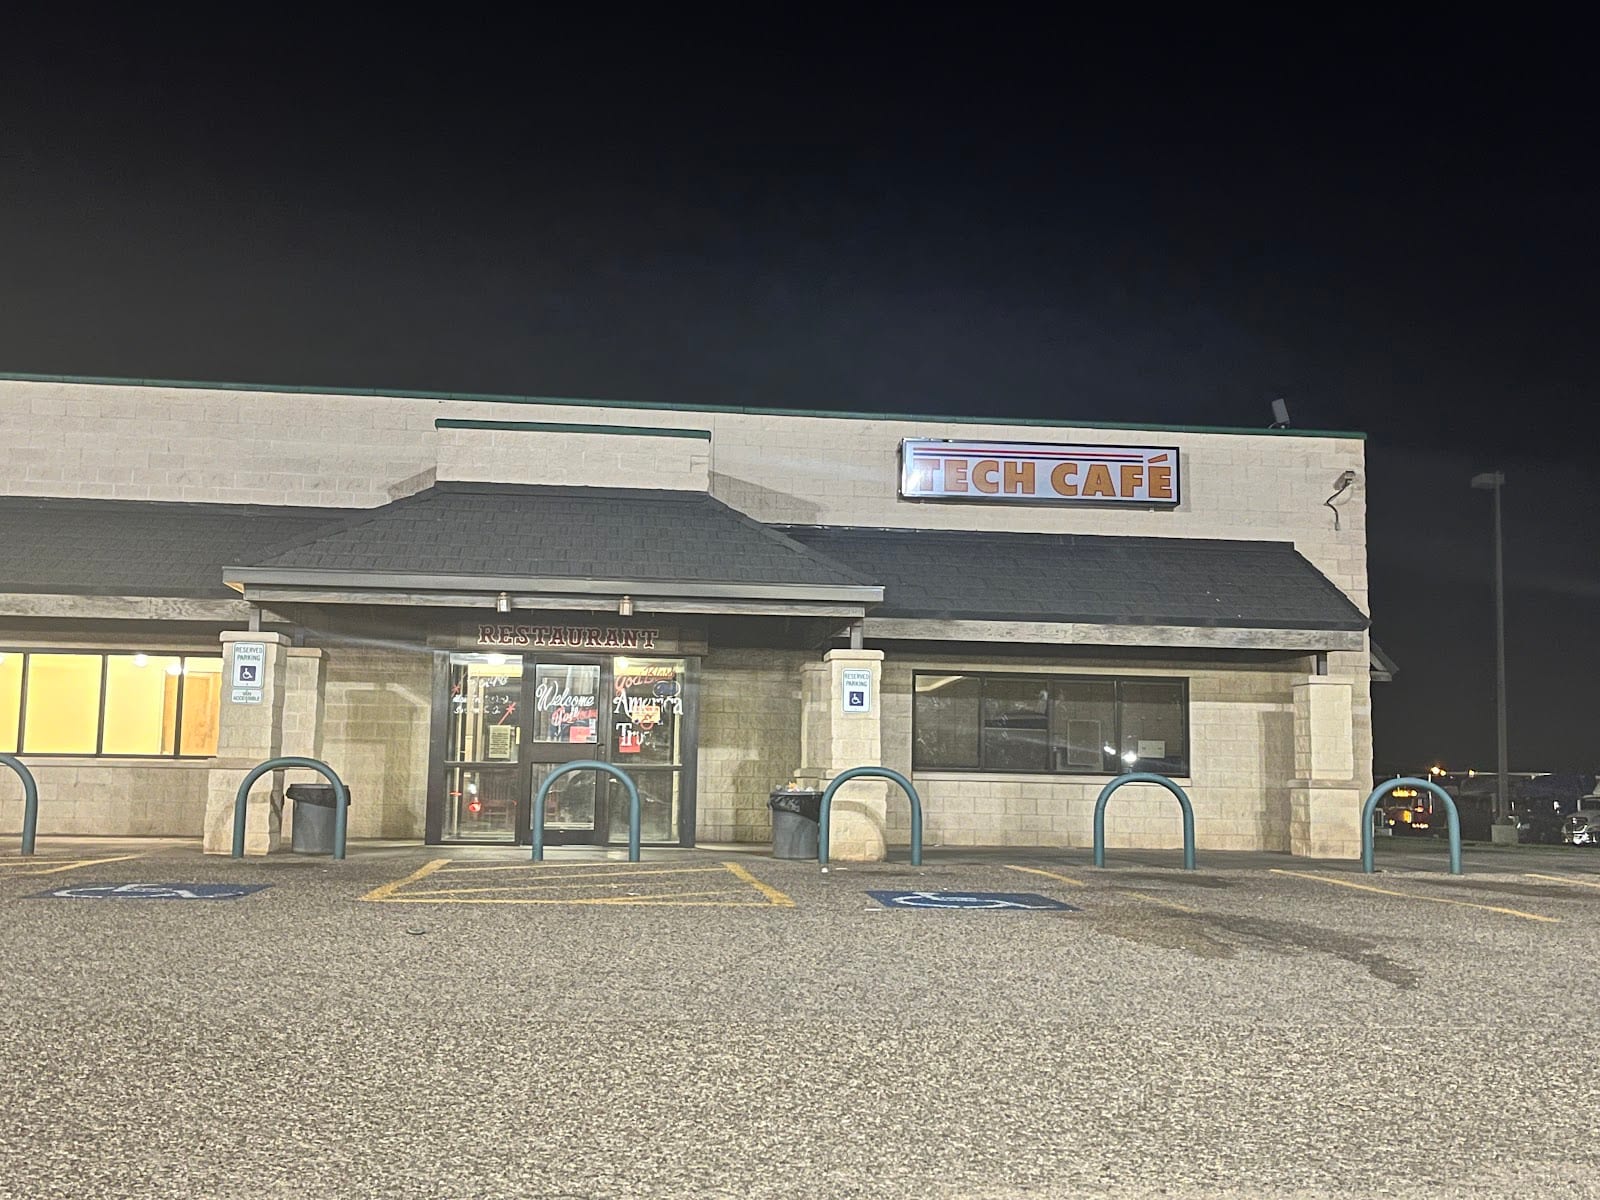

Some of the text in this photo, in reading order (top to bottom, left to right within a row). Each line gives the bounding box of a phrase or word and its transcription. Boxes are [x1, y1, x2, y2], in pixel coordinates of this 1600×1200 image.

[913, 453, 1172, 499] TECH CAFÉ
[478, 624, 659, 650] RESTAURANT
[535, 681, 595, 712] Welcome
[612, 688, 684, 718] America
